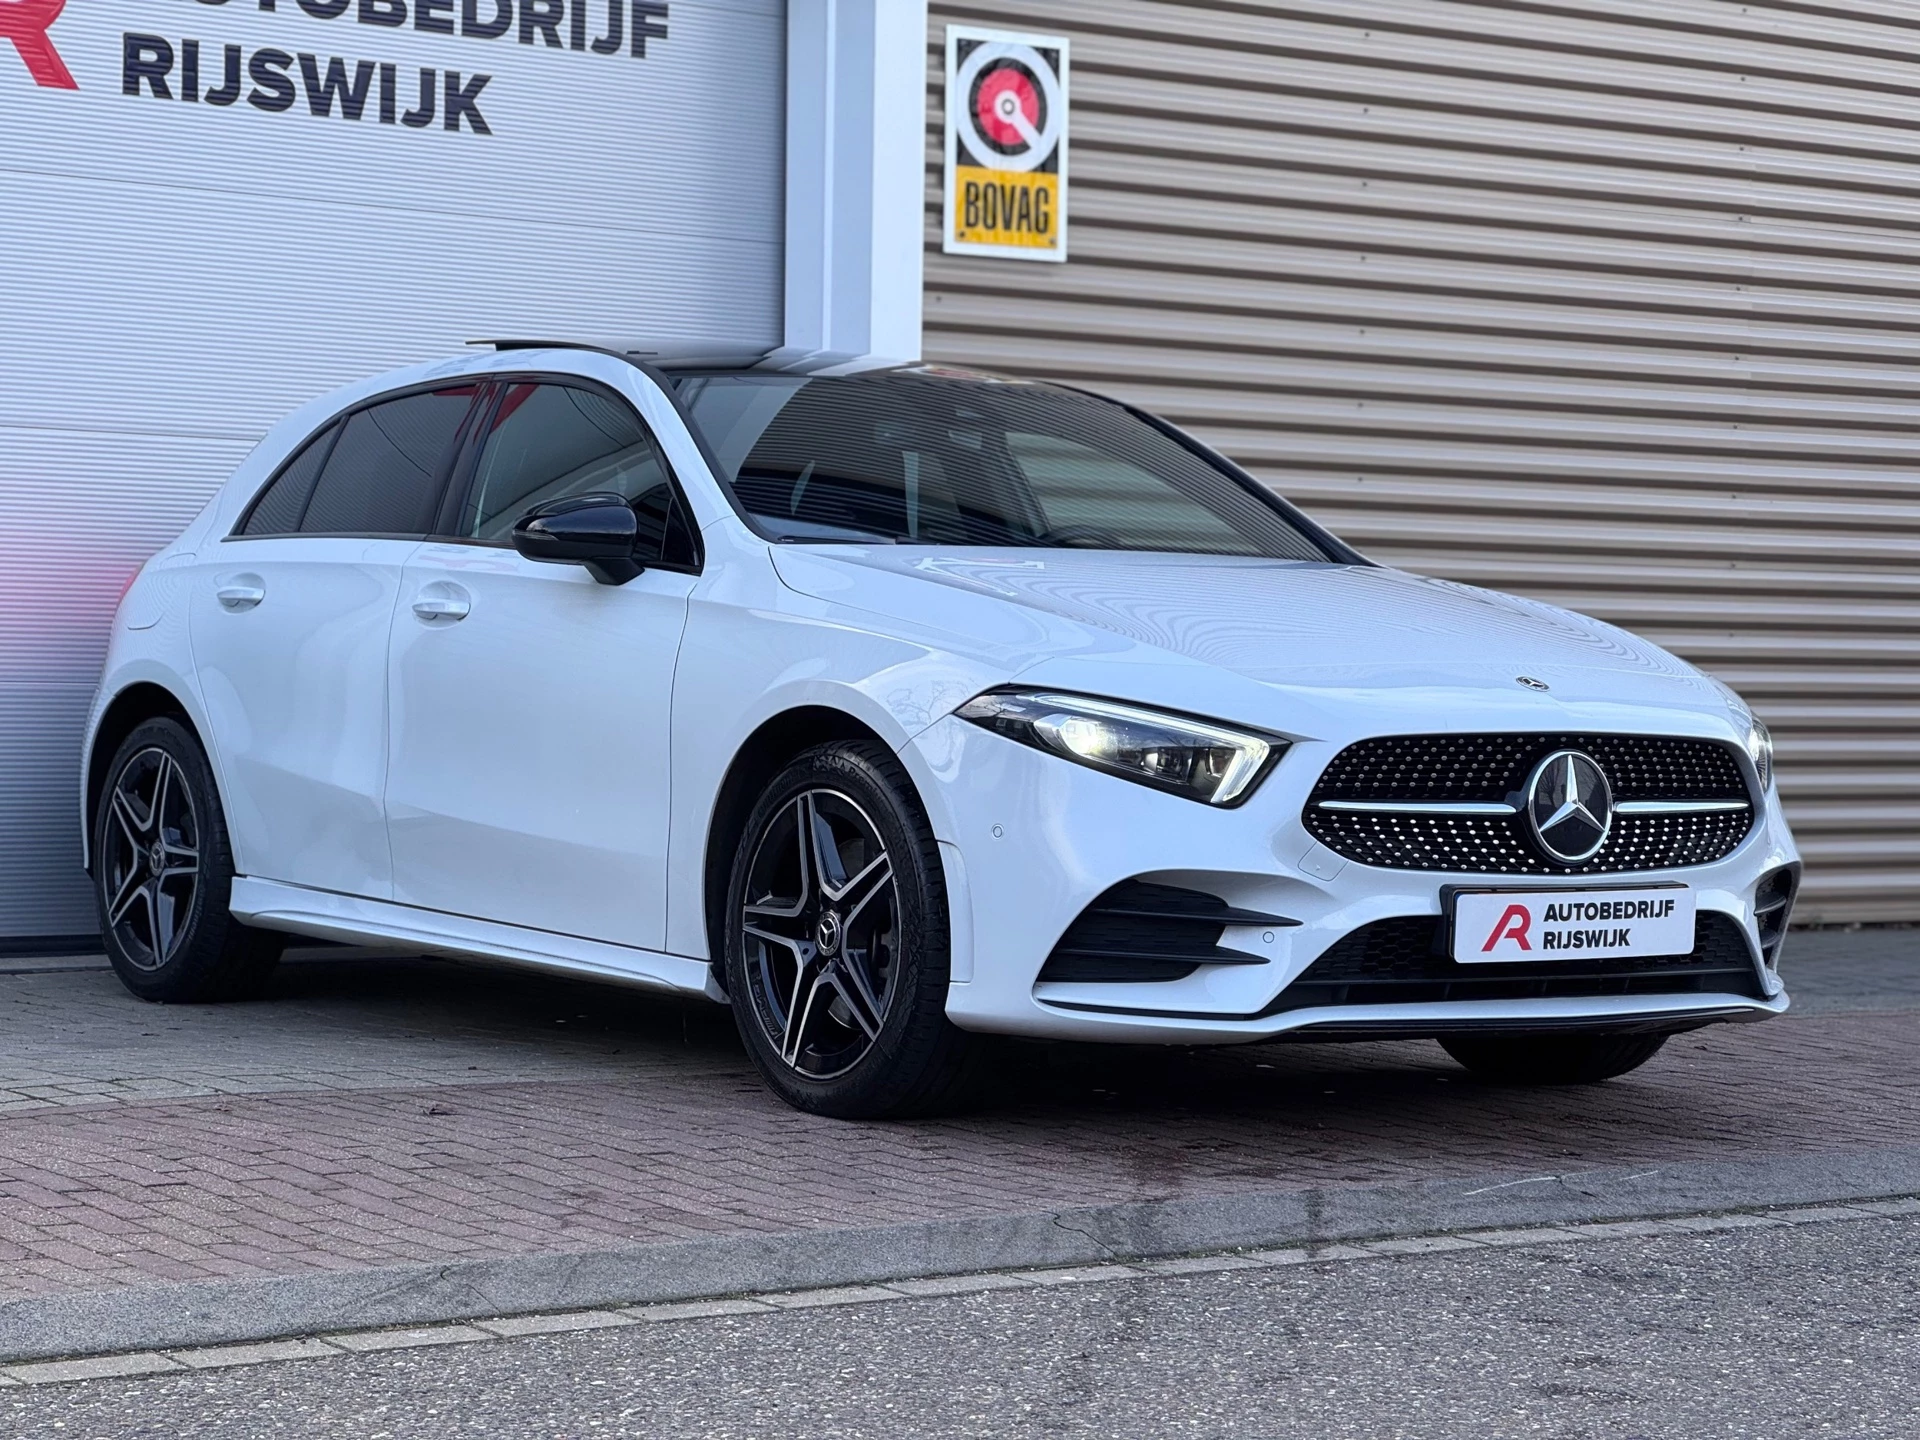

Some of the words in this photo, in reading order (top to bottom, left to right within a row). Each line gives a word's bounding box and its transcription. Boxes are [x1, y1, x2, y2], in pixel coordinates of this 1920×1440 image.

[121, 32, 494, 136] RIJSWIJK
[965, 181, 1049, 234] BOVAG
[1543, 900, 1674, 922] AUTOBEDRIJF
[1543, 928, 1631, 950] RIJSWIJK
